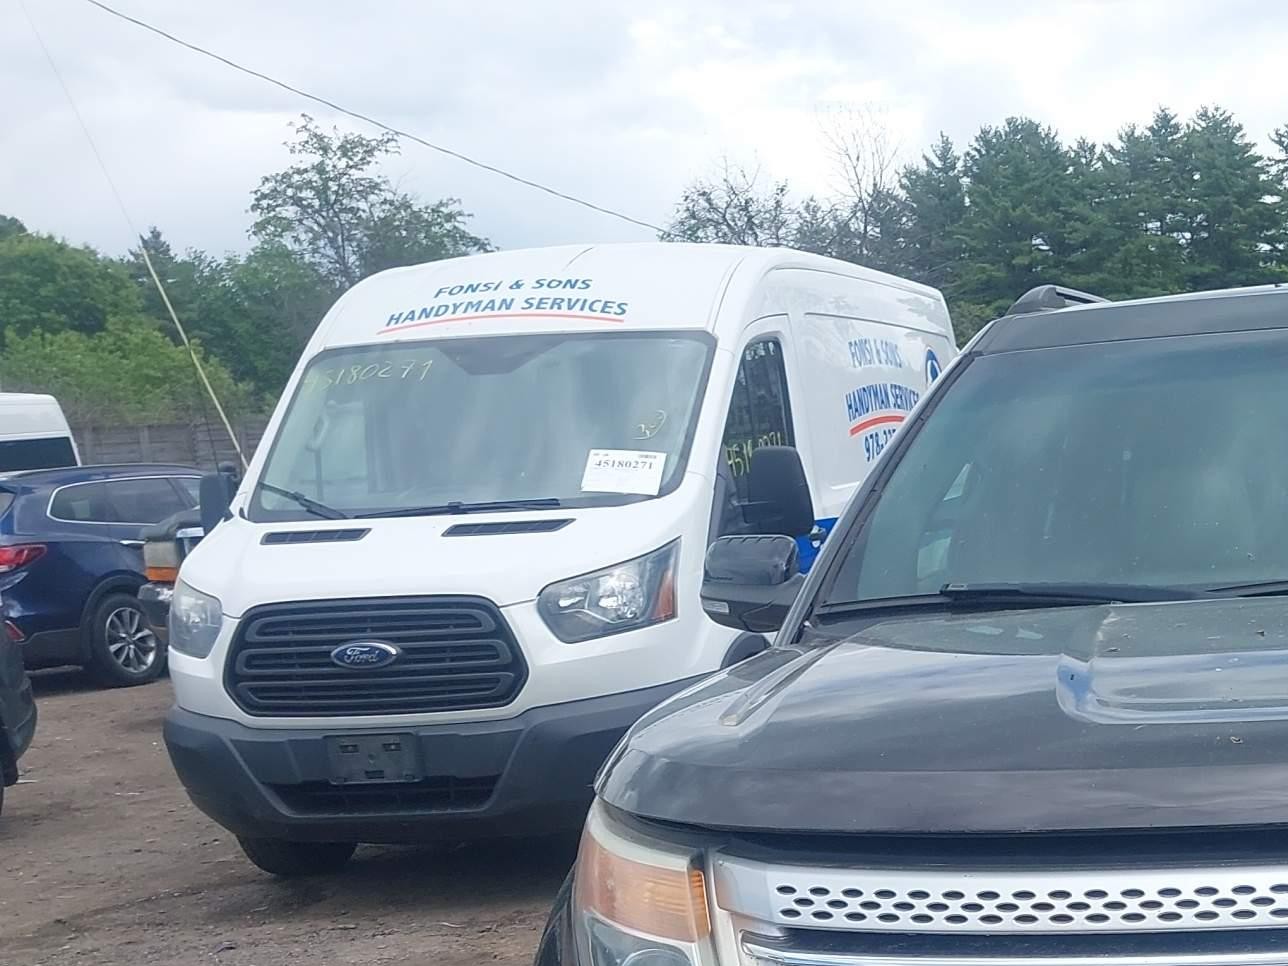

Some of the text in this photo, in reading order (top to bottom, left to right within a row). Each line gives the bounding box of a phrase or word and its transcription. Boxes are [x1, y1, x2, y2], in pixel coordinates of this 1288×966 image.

[433, 278, 593, 299] FONSI & SONS
[385, 296, 628, 327] HANDYMAN SERVICES
[848, 338, 874, 368] FONSI
[845, 383, 891, 422] HANDYMAN
[593, 459, 654, 471] 45180271
[344, 647, 381, 664] Ford
